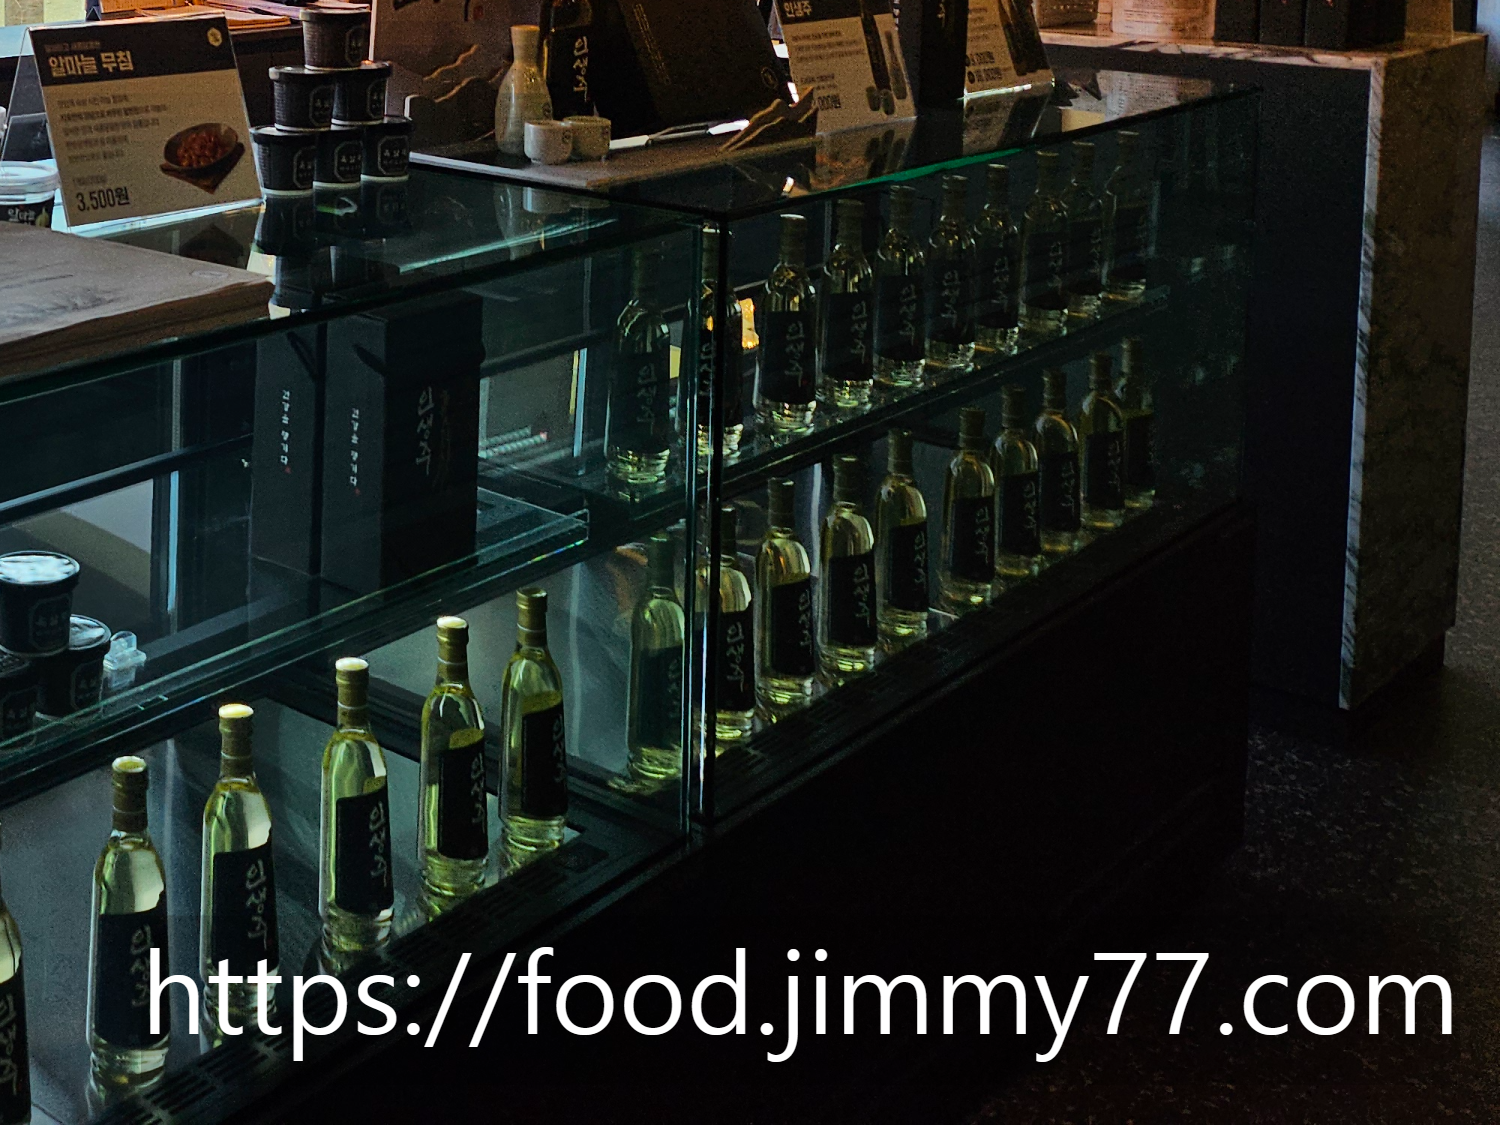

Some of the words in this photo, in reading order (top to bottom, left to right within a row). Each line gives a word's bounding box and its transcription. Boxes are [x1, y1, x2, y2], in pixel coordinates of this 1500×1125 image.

[49, 53, 99, 78] 알마늘
[100, 50, 135, 73] 무침
[573, 36, 590, 103] 인생주
[415, 386, 435, 475] 인생주
[369, 800, 389, 889] 인생주
[244, 859, 267, 952] 인생주
